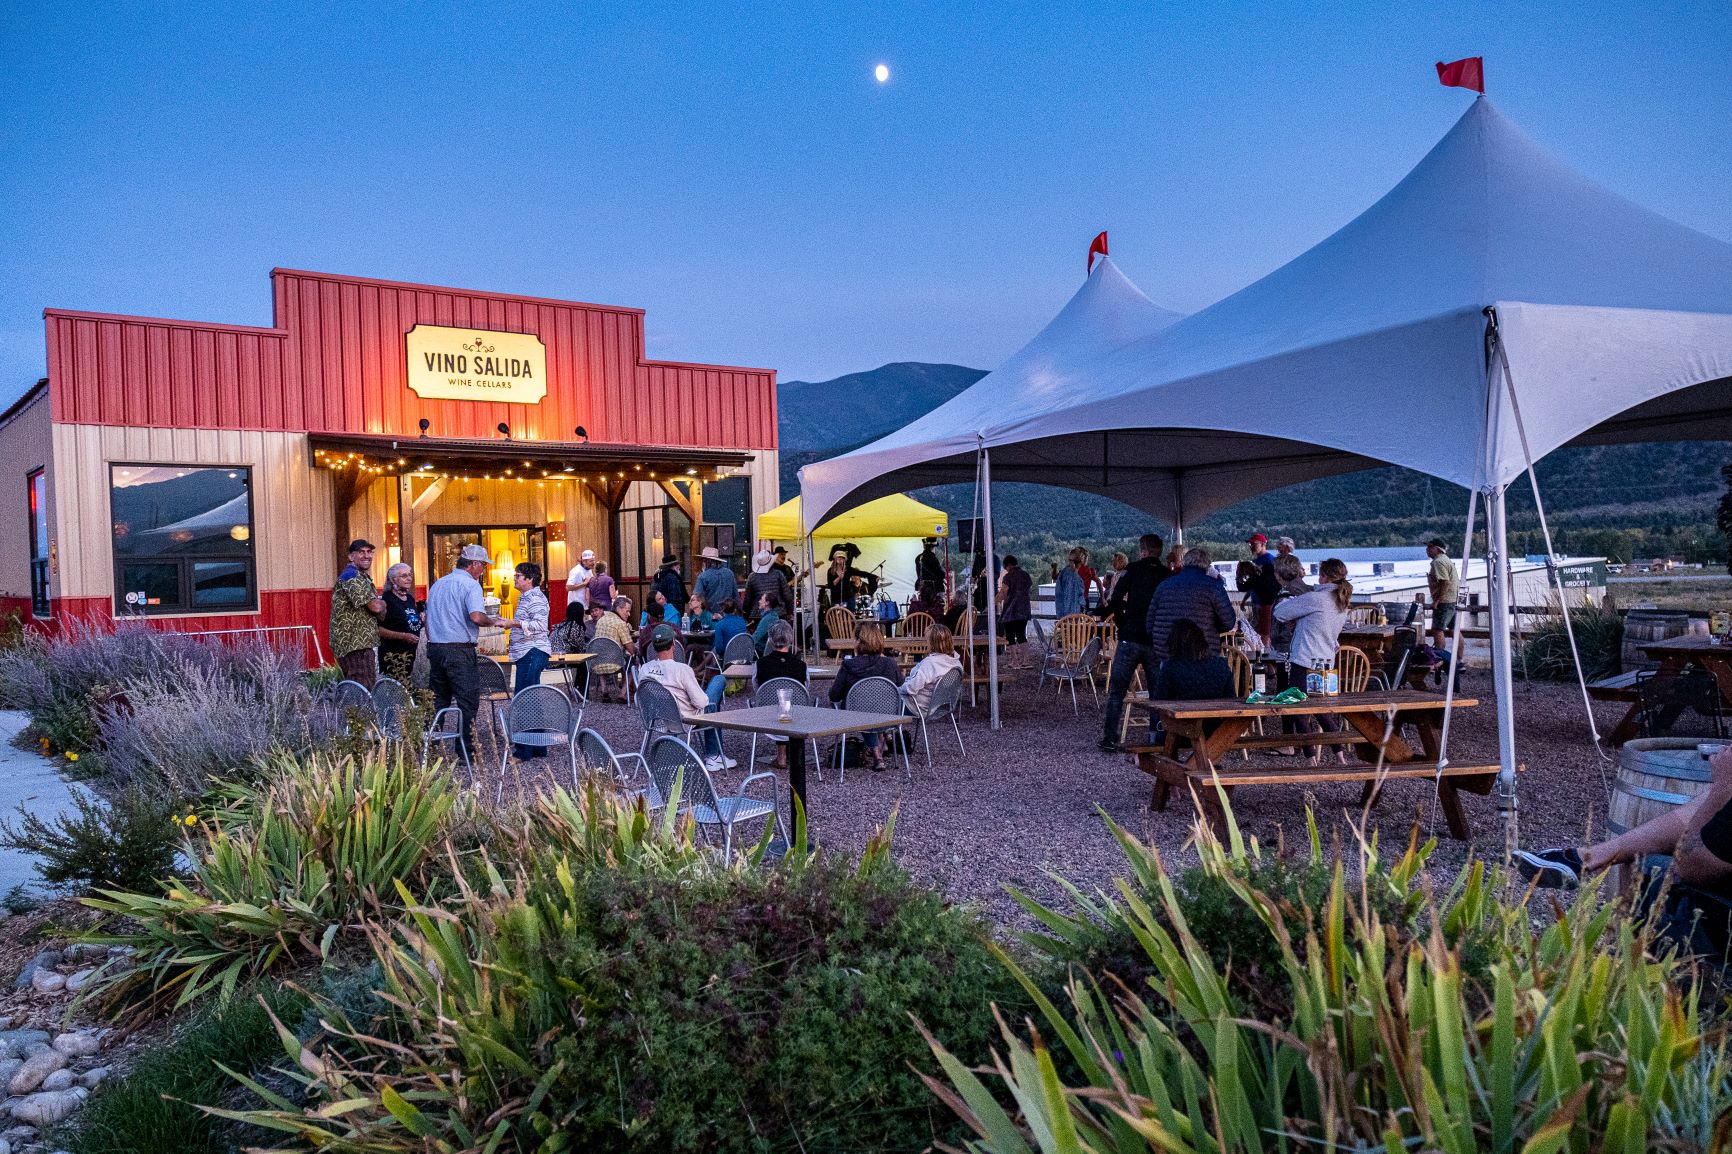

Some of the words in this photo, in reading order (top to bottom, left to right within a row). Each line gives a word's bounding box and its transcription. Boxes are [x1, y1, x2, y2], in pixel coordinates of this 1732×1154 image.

[424, 352, 467, 374] VINO
[474, 356, 532, 379] SALIDA
[448, 378, 472, 387] WINE
[476, 380, 512, 389] CELLARS
